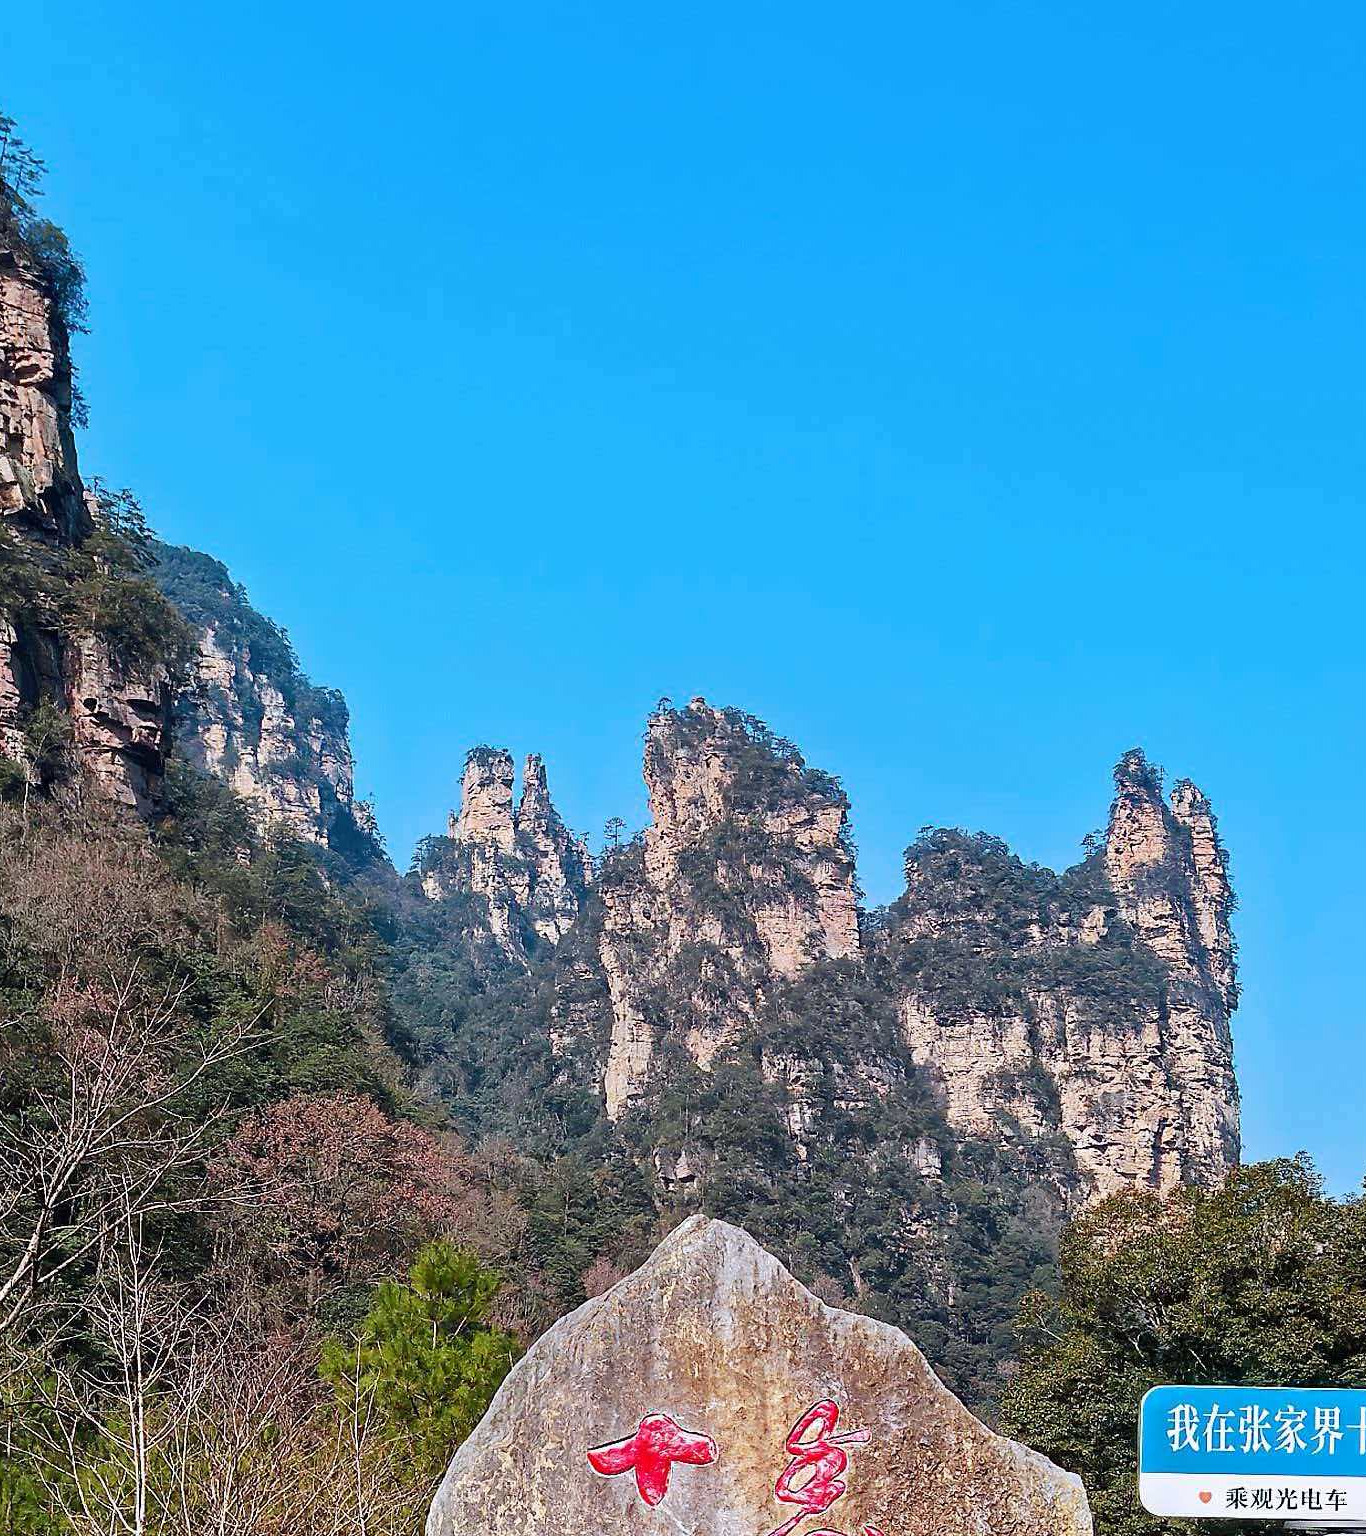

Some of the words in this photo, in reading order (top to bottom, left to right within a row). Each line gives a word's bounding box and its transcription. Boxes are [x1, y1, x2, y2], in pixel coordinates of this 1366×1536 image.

[1225, 1487, 1349, 1513] 乘观光电车
